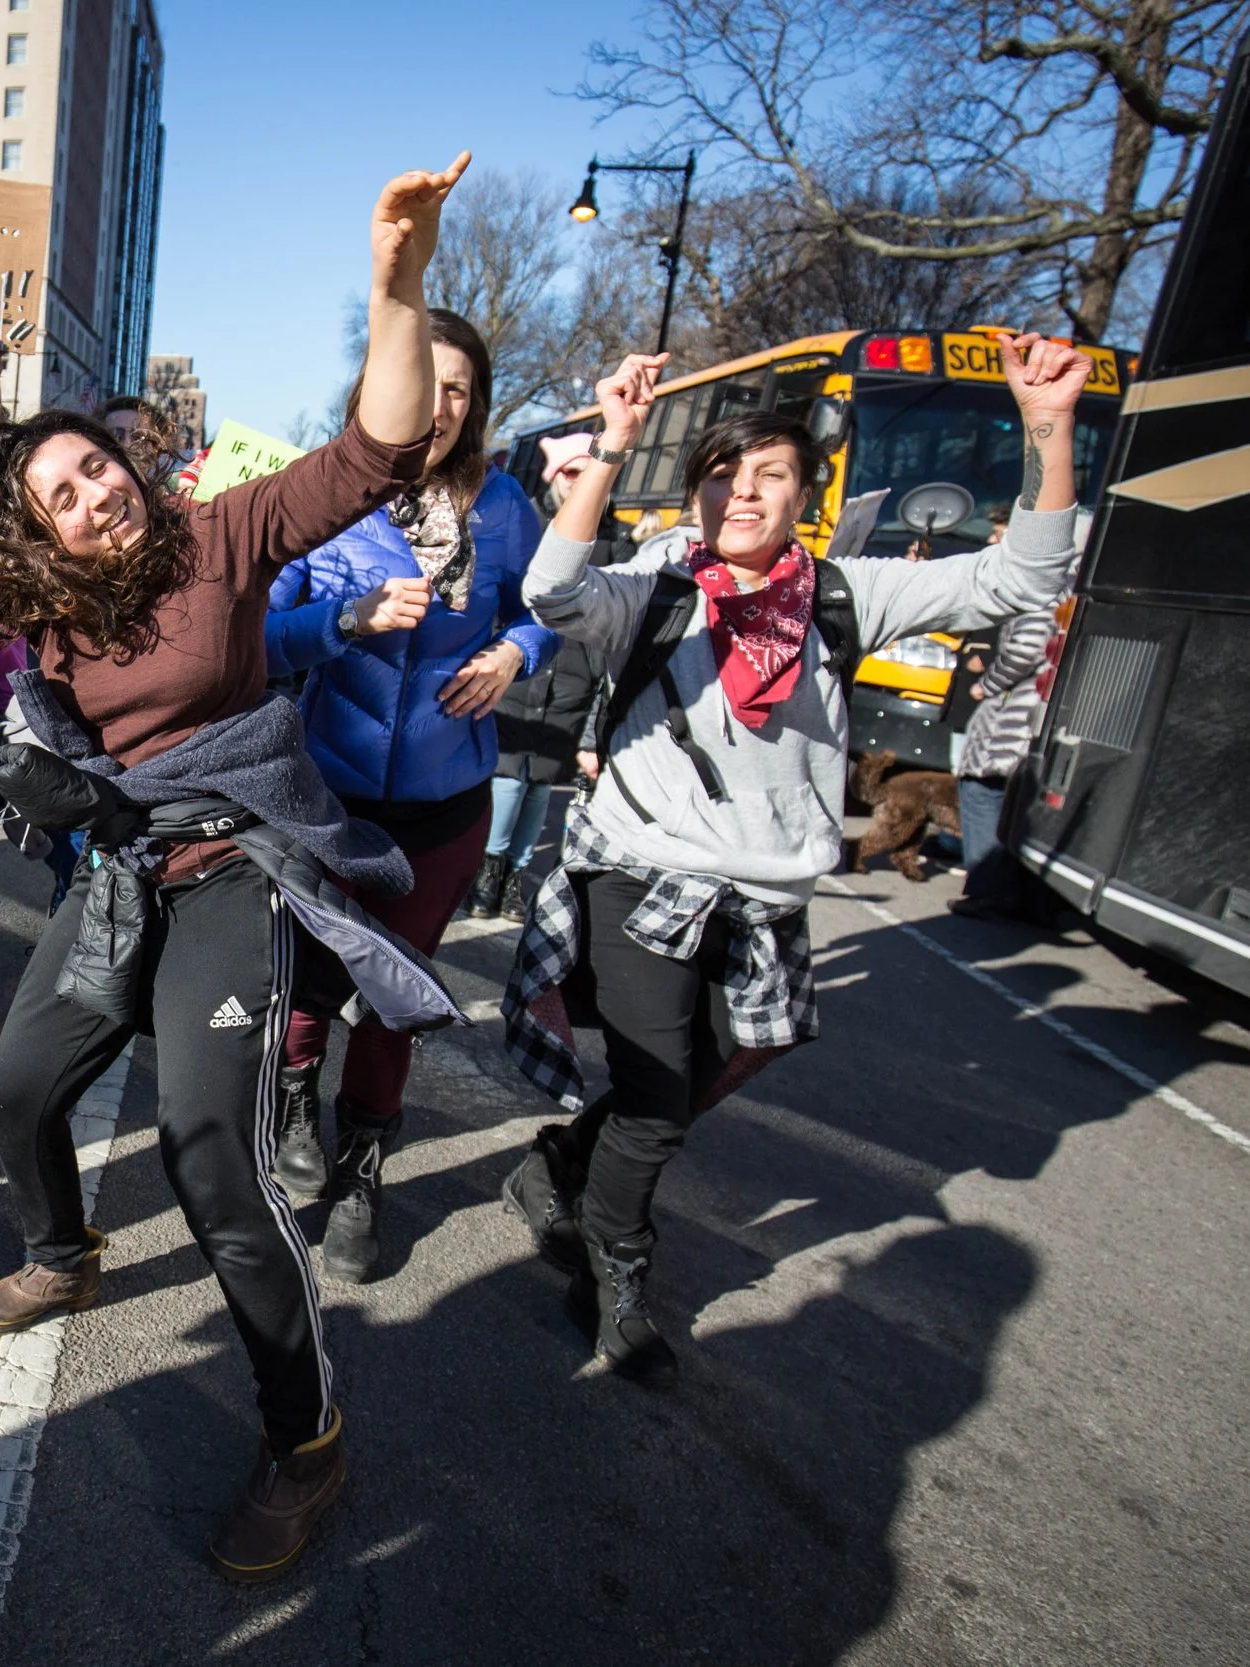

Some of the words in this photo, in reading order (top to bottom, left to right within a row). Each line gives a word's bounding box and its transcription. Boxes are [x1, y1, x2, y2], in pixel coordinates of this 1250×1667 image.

[231, 440, 249, 455] IF
[255, 449, 262, 463] I
[209, 1014, 253, 1029] adidas
